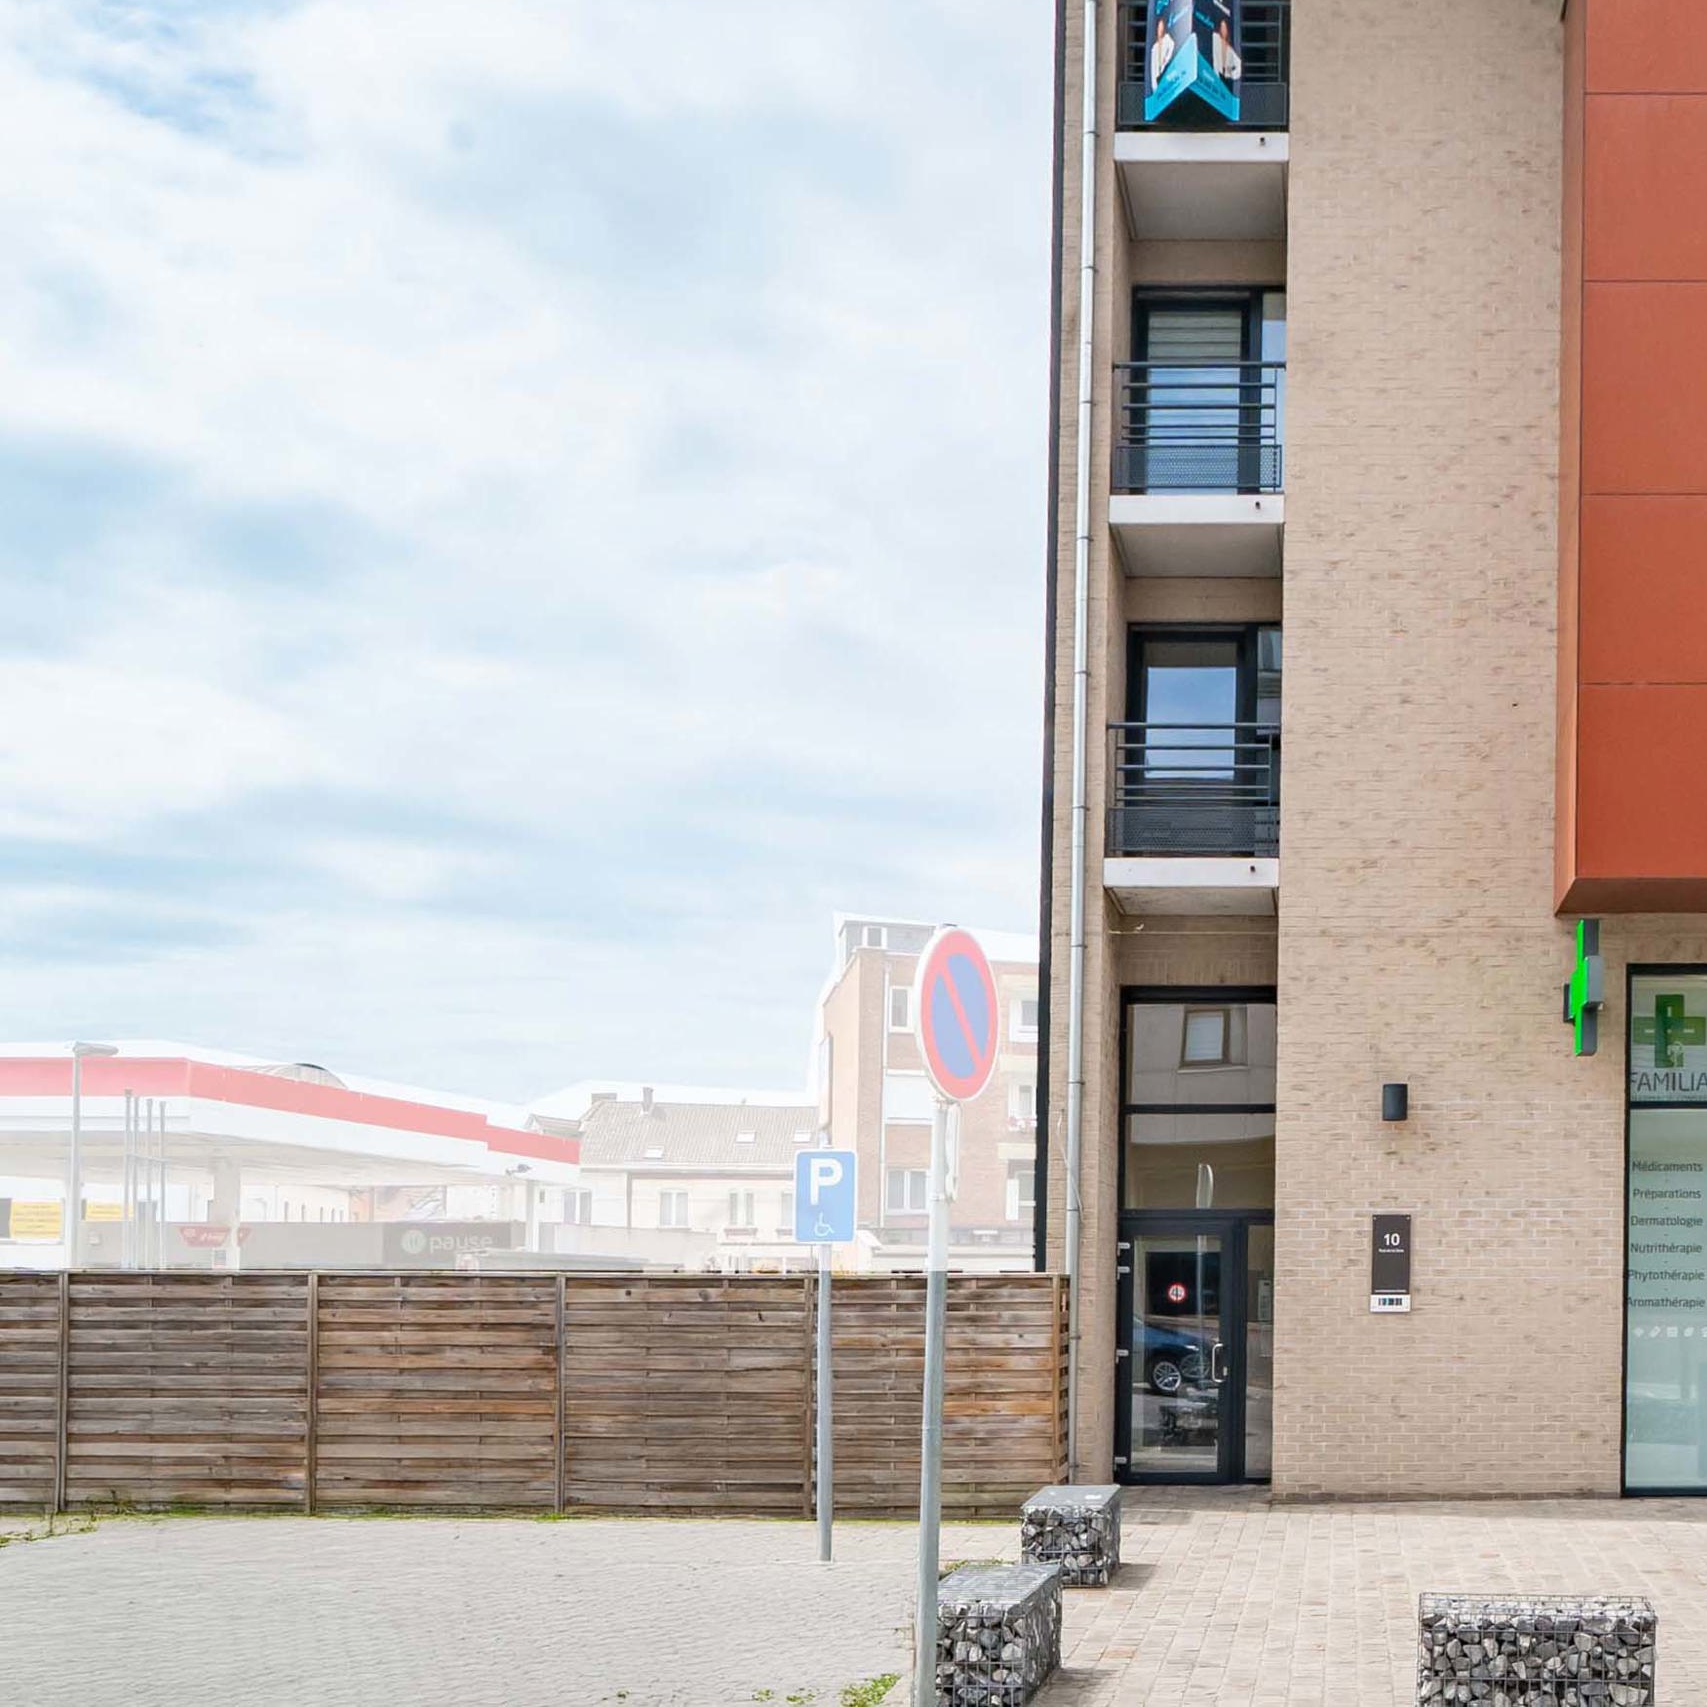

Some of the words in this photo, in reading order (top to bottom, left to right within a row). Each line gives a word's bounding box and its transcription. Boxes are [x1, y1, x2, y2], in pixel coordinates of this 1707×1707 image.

[1632, 1160, 1704, 1173] Médicaments
[810, 1157, 843, 1206] P
[1633, 1188, 1702, 1201] Préparations
[1630, 1215, 1704, 1228] Dermatologie
[429, 1234, 494, 1254] pause
[1383, 1233, 1401, 1246] 10
[1630, 1243, 1703, 1256] Nutrithérapie
[1628, 1269, 1705, 1283] Phytothérapie
[1627, 1296, 1706, 1310] Aromathérapie
